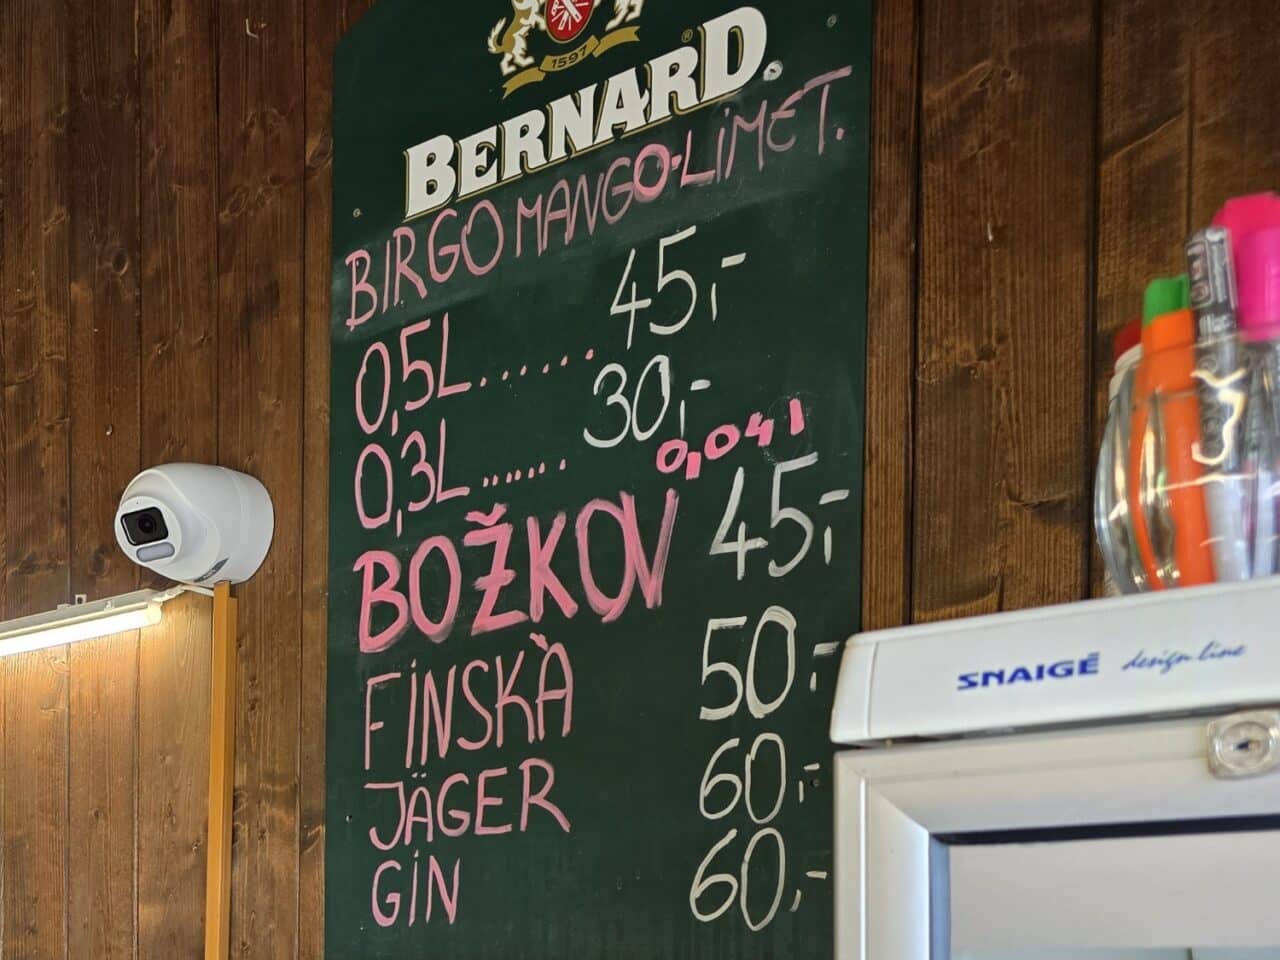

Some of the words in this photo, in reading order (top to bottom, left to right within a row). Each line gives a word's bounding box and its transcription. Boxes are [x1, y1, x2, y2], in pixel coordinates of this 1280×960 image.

[550, 47, 588, 70] 1597
[403, 7, 767, 222] BERNARD
[344, 200, 504, 330] BIRGO
[610, 225, 747, 349] 45,-
[583, 355, 711, 448] 30,-
[353, 487, 680, 653] BOŽKOV
[709, 452, 850, 580] 45,-
[1122, 648, 1192, 676] design
[1197, 640, 1248, 664] line
[363, 758, 571, 851] JÄGER
[370, 850, 461, 927] GIN
[689, 827, 827, 932] 60,-
